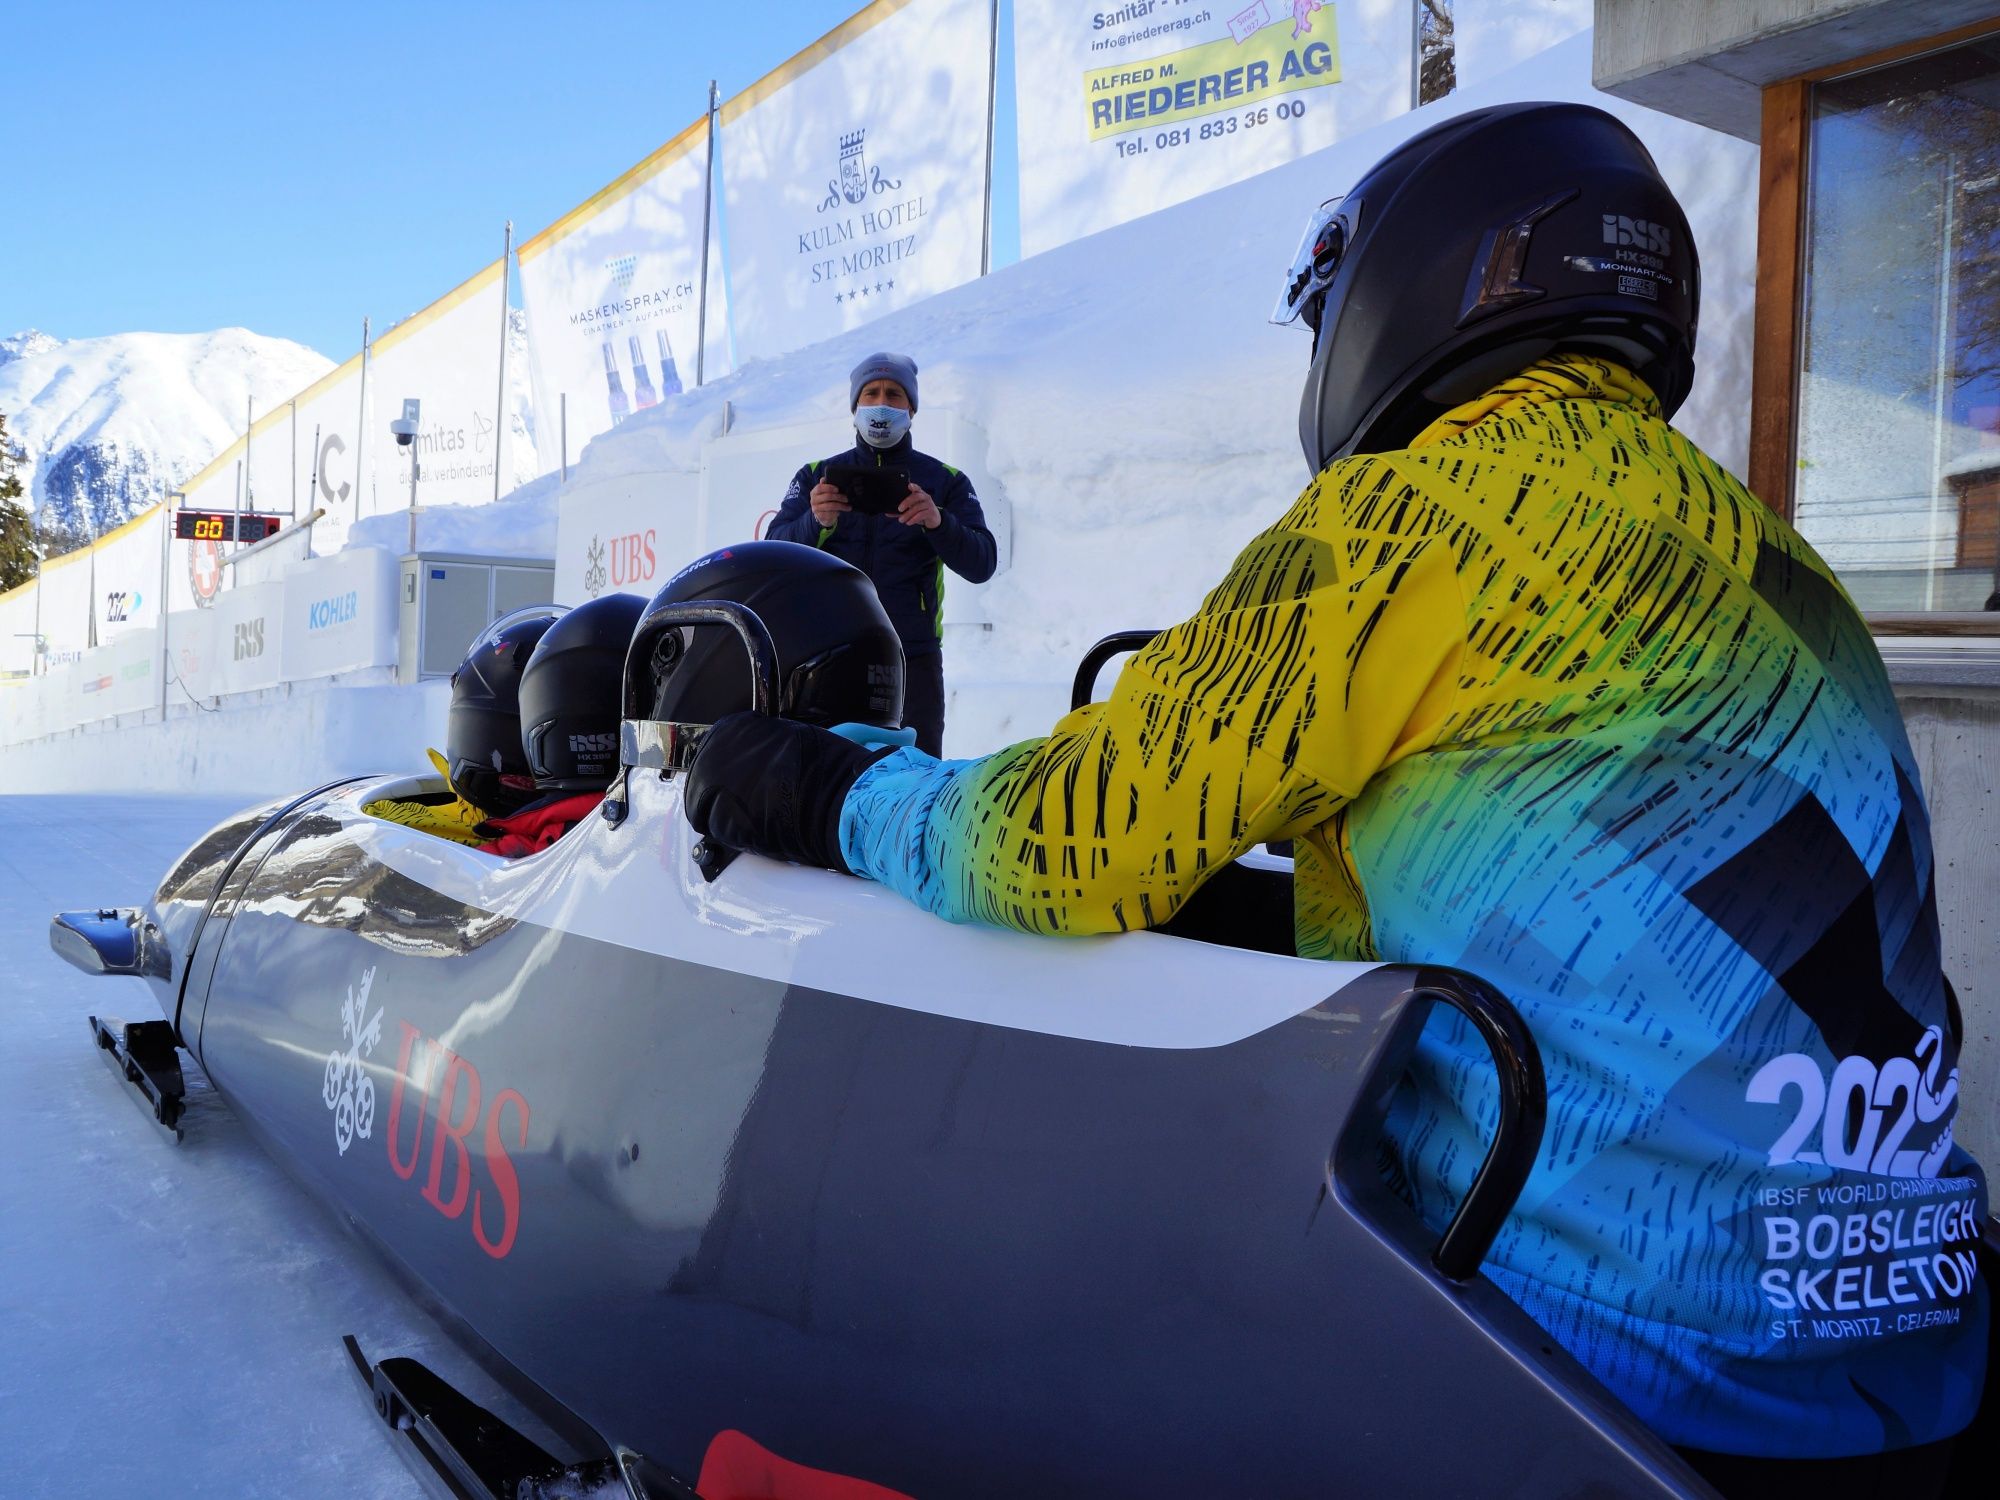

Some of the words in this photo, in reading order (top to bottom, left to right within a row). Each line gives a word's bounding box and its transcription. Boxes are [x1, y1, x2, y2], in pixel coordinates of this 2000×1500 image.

[1091, 10, 1211, 51] info@riedererag.ch
[1092, 0, 1153, 30] Sanitär
[1236, 9, 1257, 26] Since
[1243, 18, 1260, 35] 1927
[1091, 68, 1154, 92] ALFRED
[1159, 64, 1178, 77] M.
[1092, 60, 1269, 128] RIEDERER
[1279, 41, 1333, 82] AG
[1116, 137, 1148, 158] Tel.
[1155, 128, 1191, 149] 081
[1199, 116, 1238, 140] 833
[1244, 108, 1268, 128] 36
[1276, 99, 1306, 118] 00
[798, 218, 854, 254] KULM
[862, 197, 929, 236] HOTEL
[1600, 262, 1656, 277] MONHART
[570, 282, 694, 326] MASKEN-SPRAY.CH
[194, 520, 224, 538] 00
[610, 529, 656, 586] UBS
[309, 591, 358, 630] KOHLER
[386, 1018, 531, 1259] UBS
[1759, 1187, 1810, 1206] IBSF
[1817, 1182, 1887, 1204] WORLD
[1763, 1198, 1980, 1261] BOBSLEIGH
[1759, 1250, 1979, 1312] SKELETON
[1771, 1320, 1808, 1339] ST.
[1813, 1317, 1884, 1339] MORITZ
[1897, 1307, 1961, 1333] CELERINA
